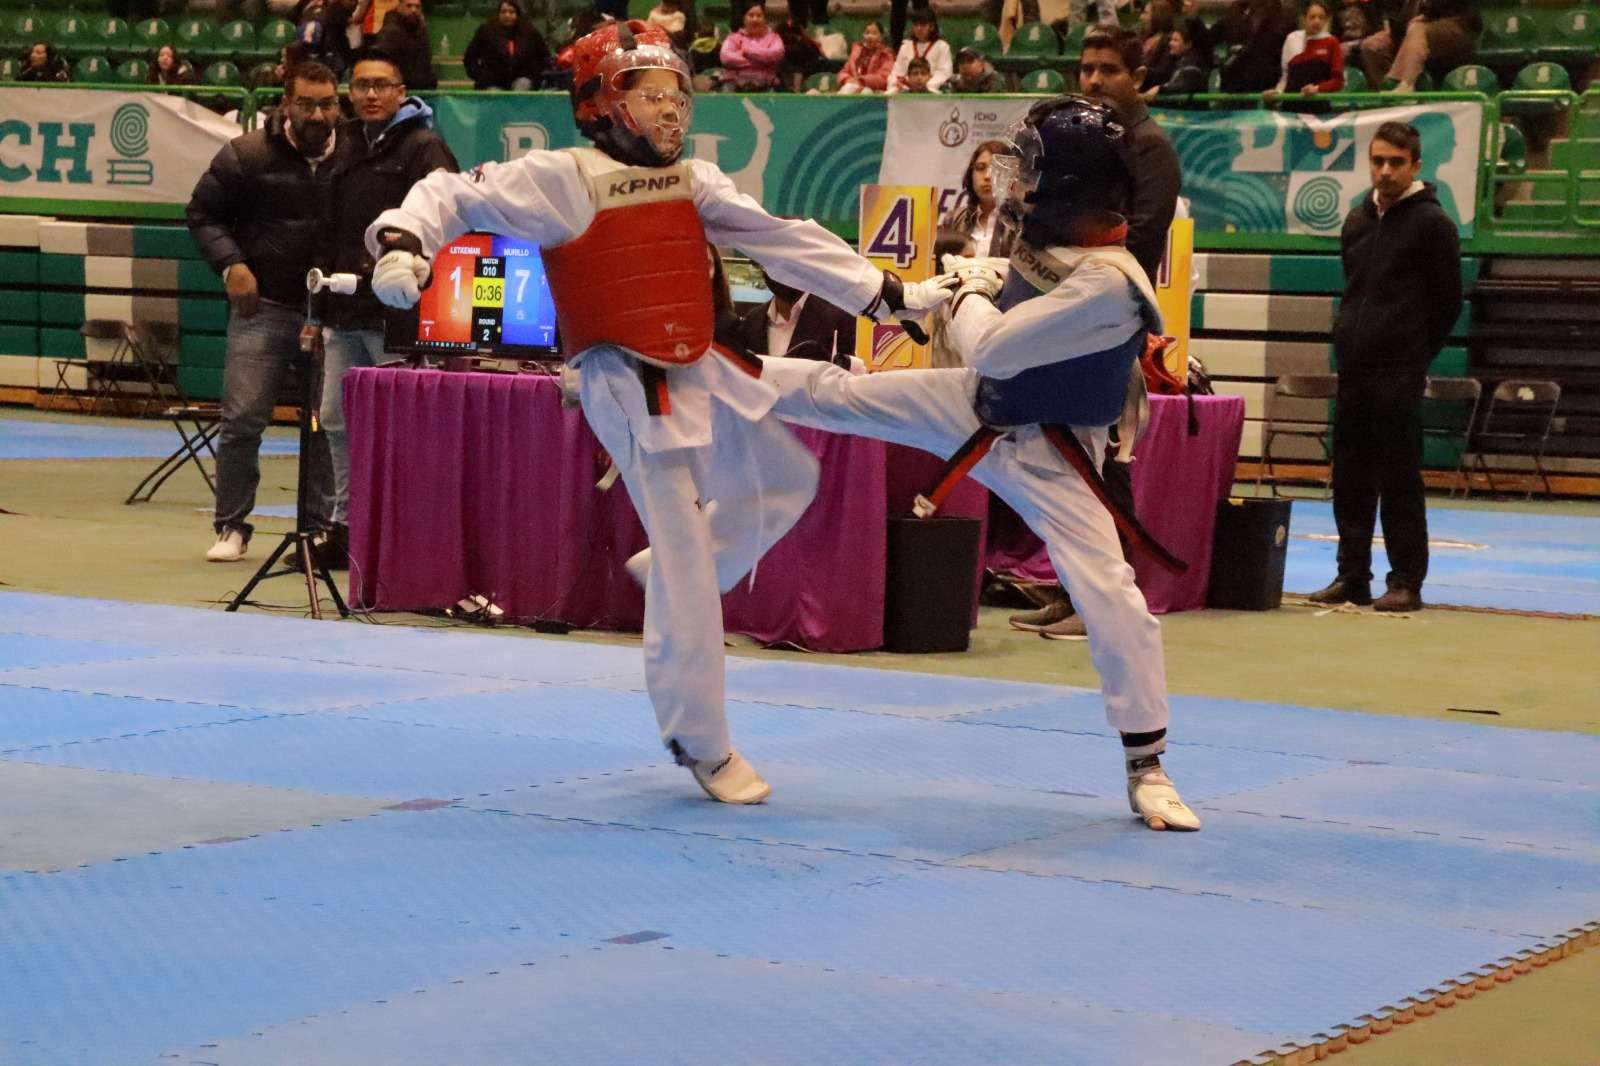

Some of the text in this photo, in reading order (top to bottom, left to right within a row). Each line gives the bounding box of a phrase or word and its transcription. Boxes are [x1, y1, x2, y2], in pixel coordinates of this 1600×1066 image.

[608, 175, 680, 197] KPNP
[866, 196, 913, 266] 4
[503, 247, 530, 256] MURILLO
[482, 266, 497, 276] 010
[1013, 246, 1060, 283] KPNP
[450, 266, 462, 300] 1
[475, 285, 502, 301] 0:36
[515, 269, 531, 303] 7
[482, 328, 490, 341] 2
